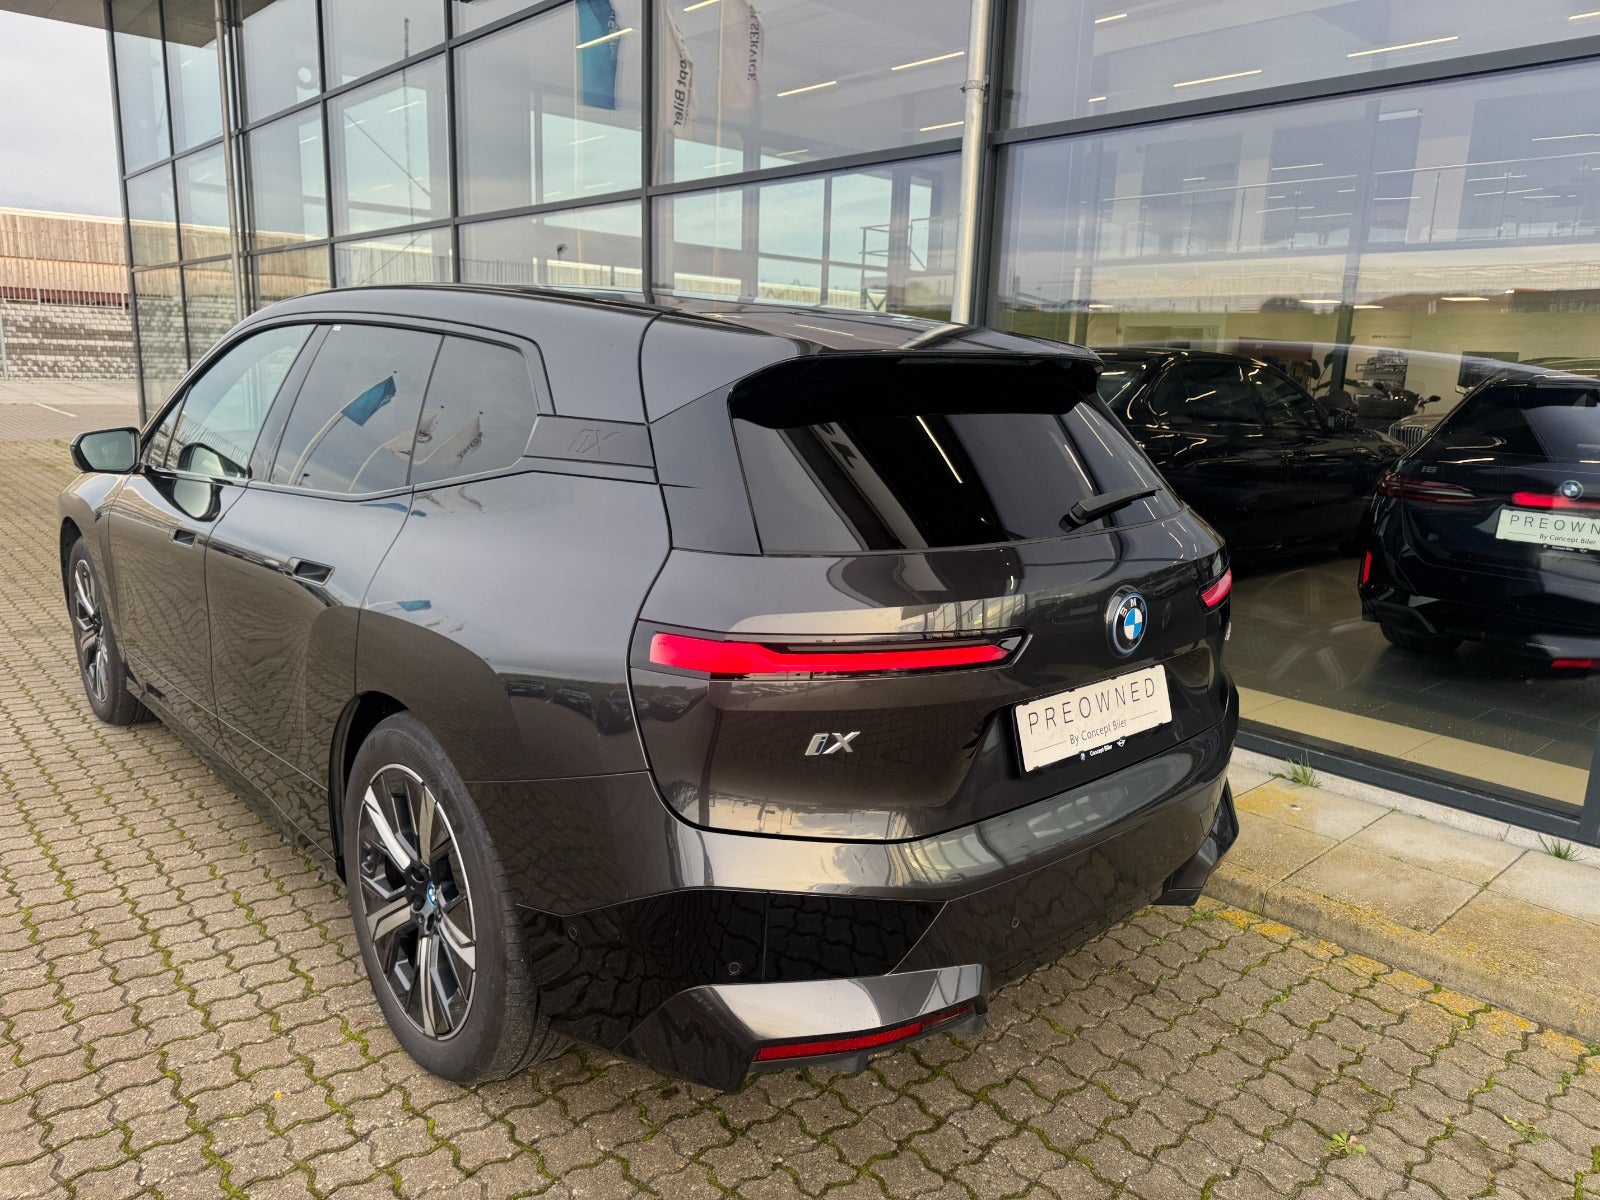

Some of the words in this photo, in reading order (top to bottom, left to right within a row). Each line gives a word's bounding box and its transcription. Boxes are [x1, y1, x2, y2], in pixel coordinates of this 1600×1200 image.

[1549, 534, 1578, 544] Concept
[1580, 537, 1597, 545] Biler
[1028, 677, 1155, 735] PREOWNED
[804, 731, 861, 756] iX
[1069, 734, 1079, 746] By
[1081, 724, 1112, 742] Concept
[1113, 718, 1127, 731] Biler
